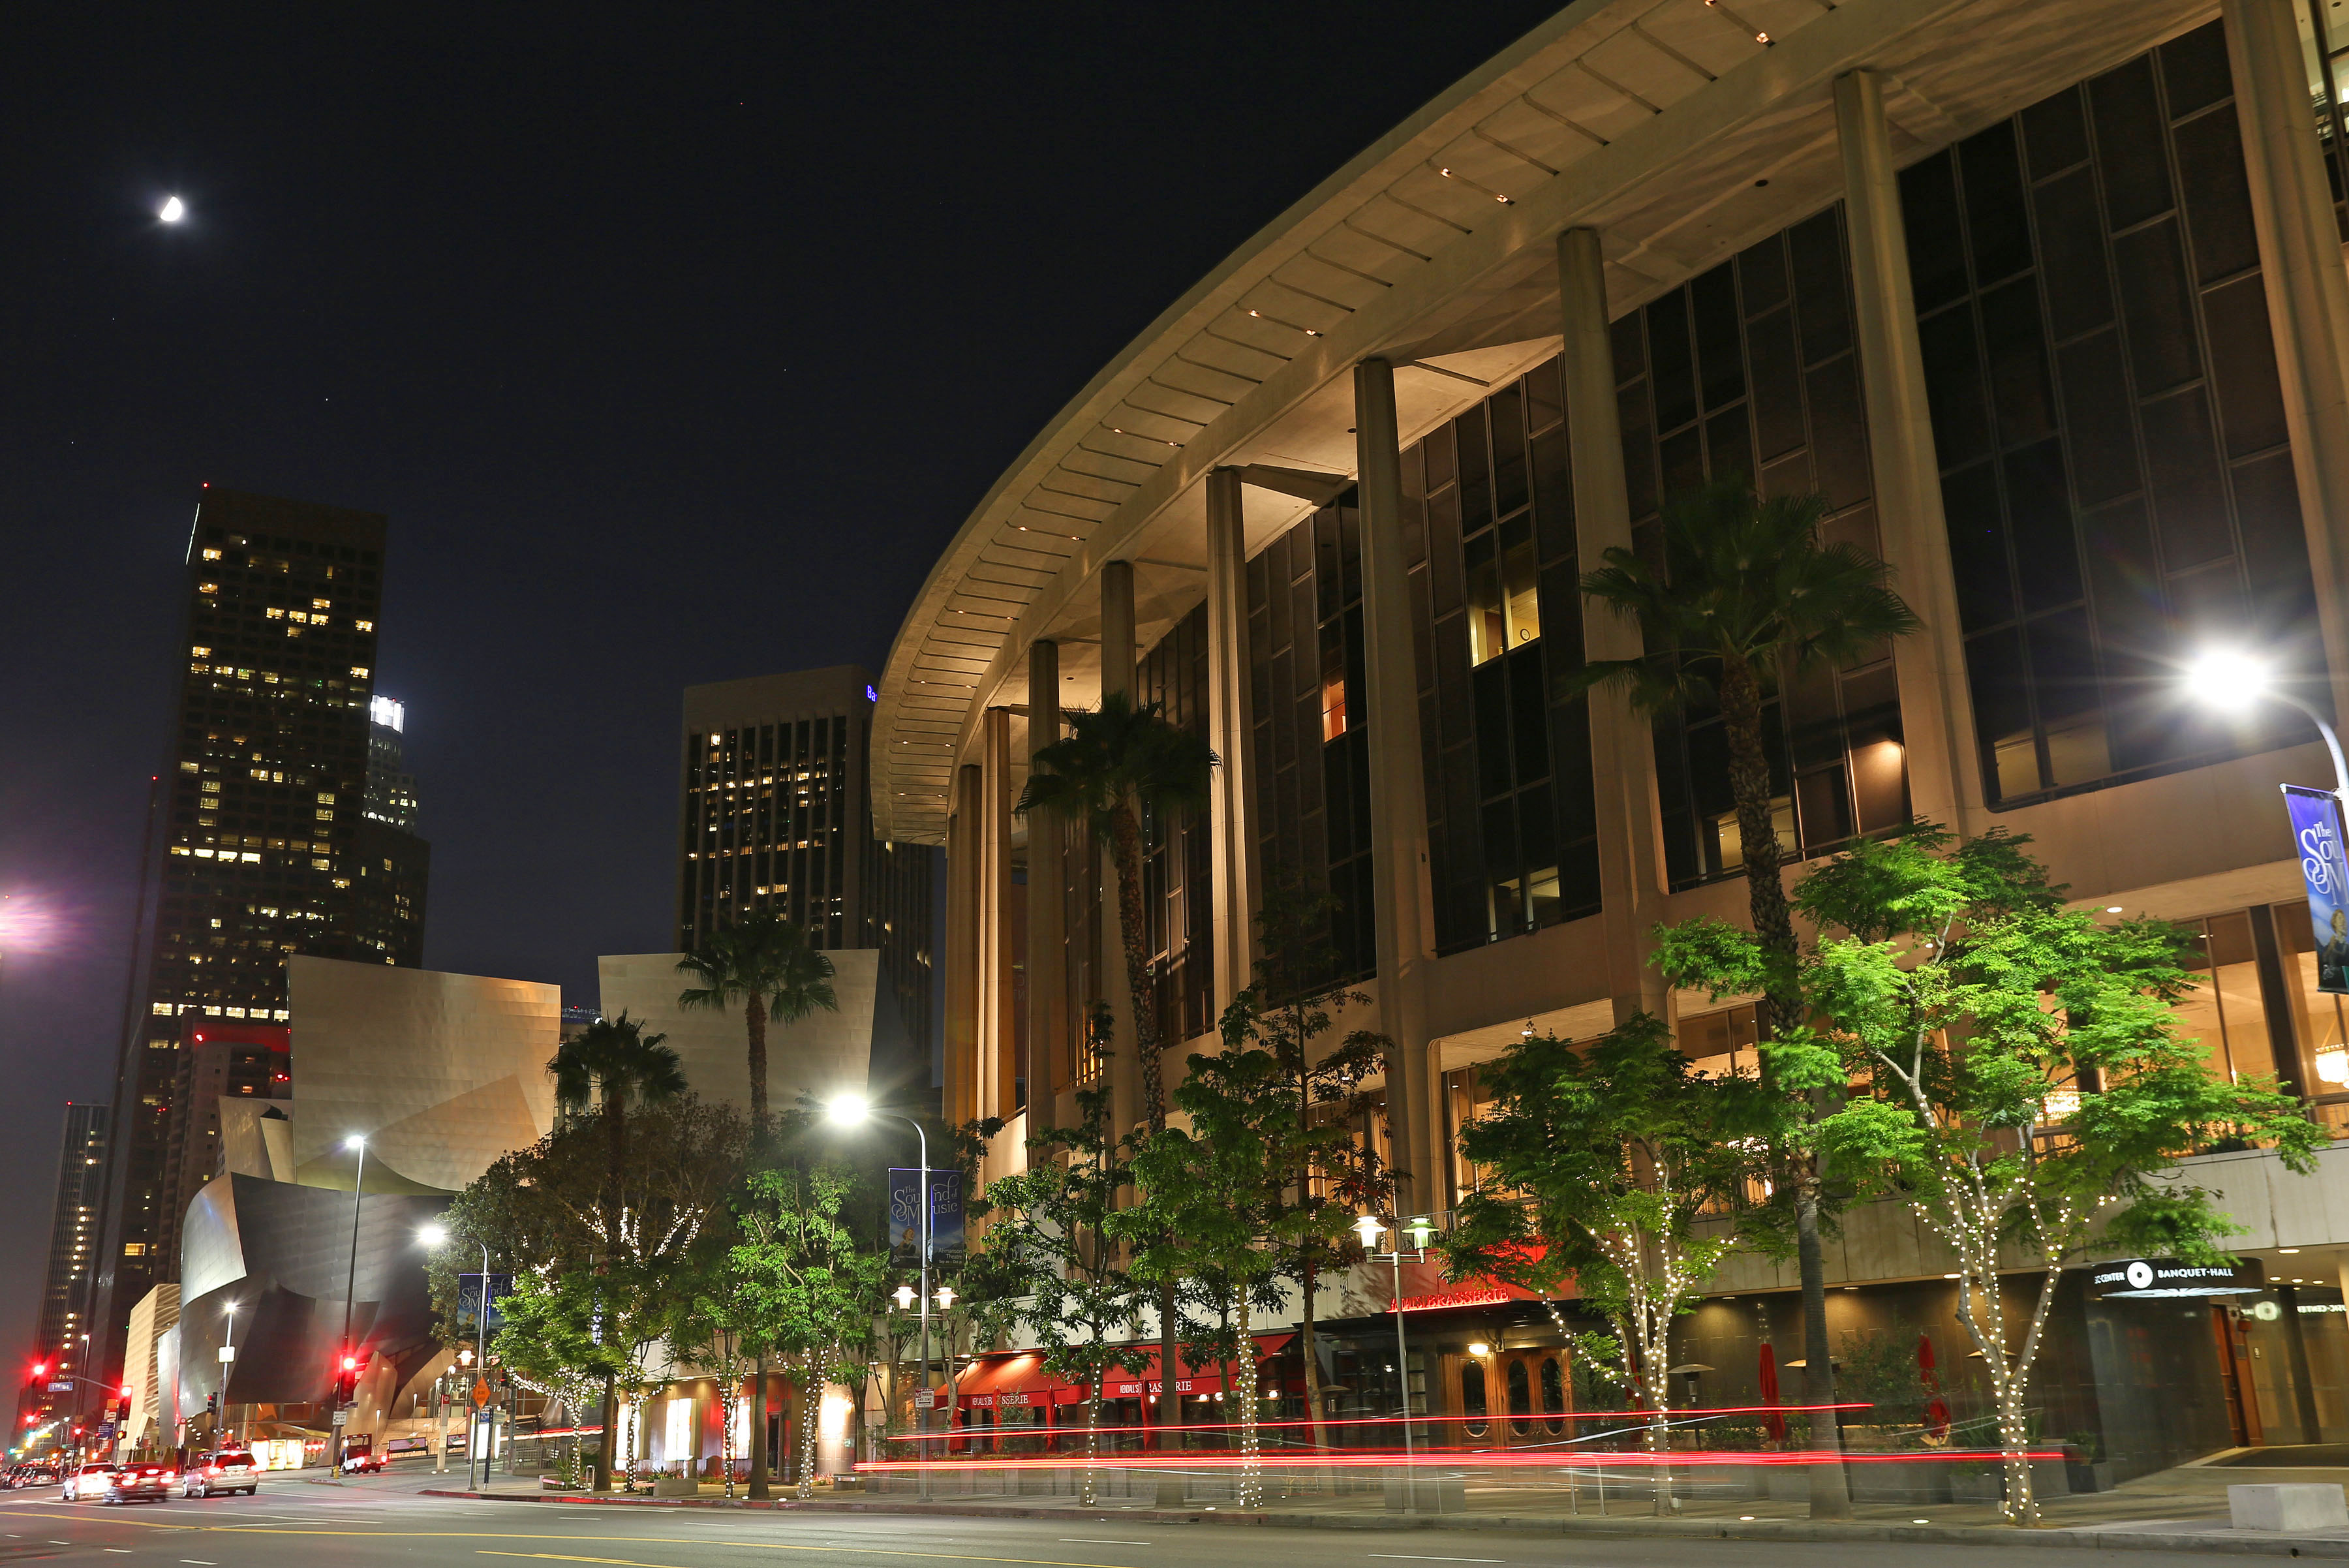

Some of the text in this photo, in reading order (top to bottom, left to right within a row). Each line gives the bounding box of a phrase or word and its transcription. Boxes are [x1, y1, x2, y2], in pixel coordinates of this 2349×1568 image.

[2313, 821, 2332, 837] The
[906, 1185, 915, 1193] The
[1426, 1288, 1509, 1307] BRASSERIE
[988, 1394, 1029, 1406] BSSERIE
